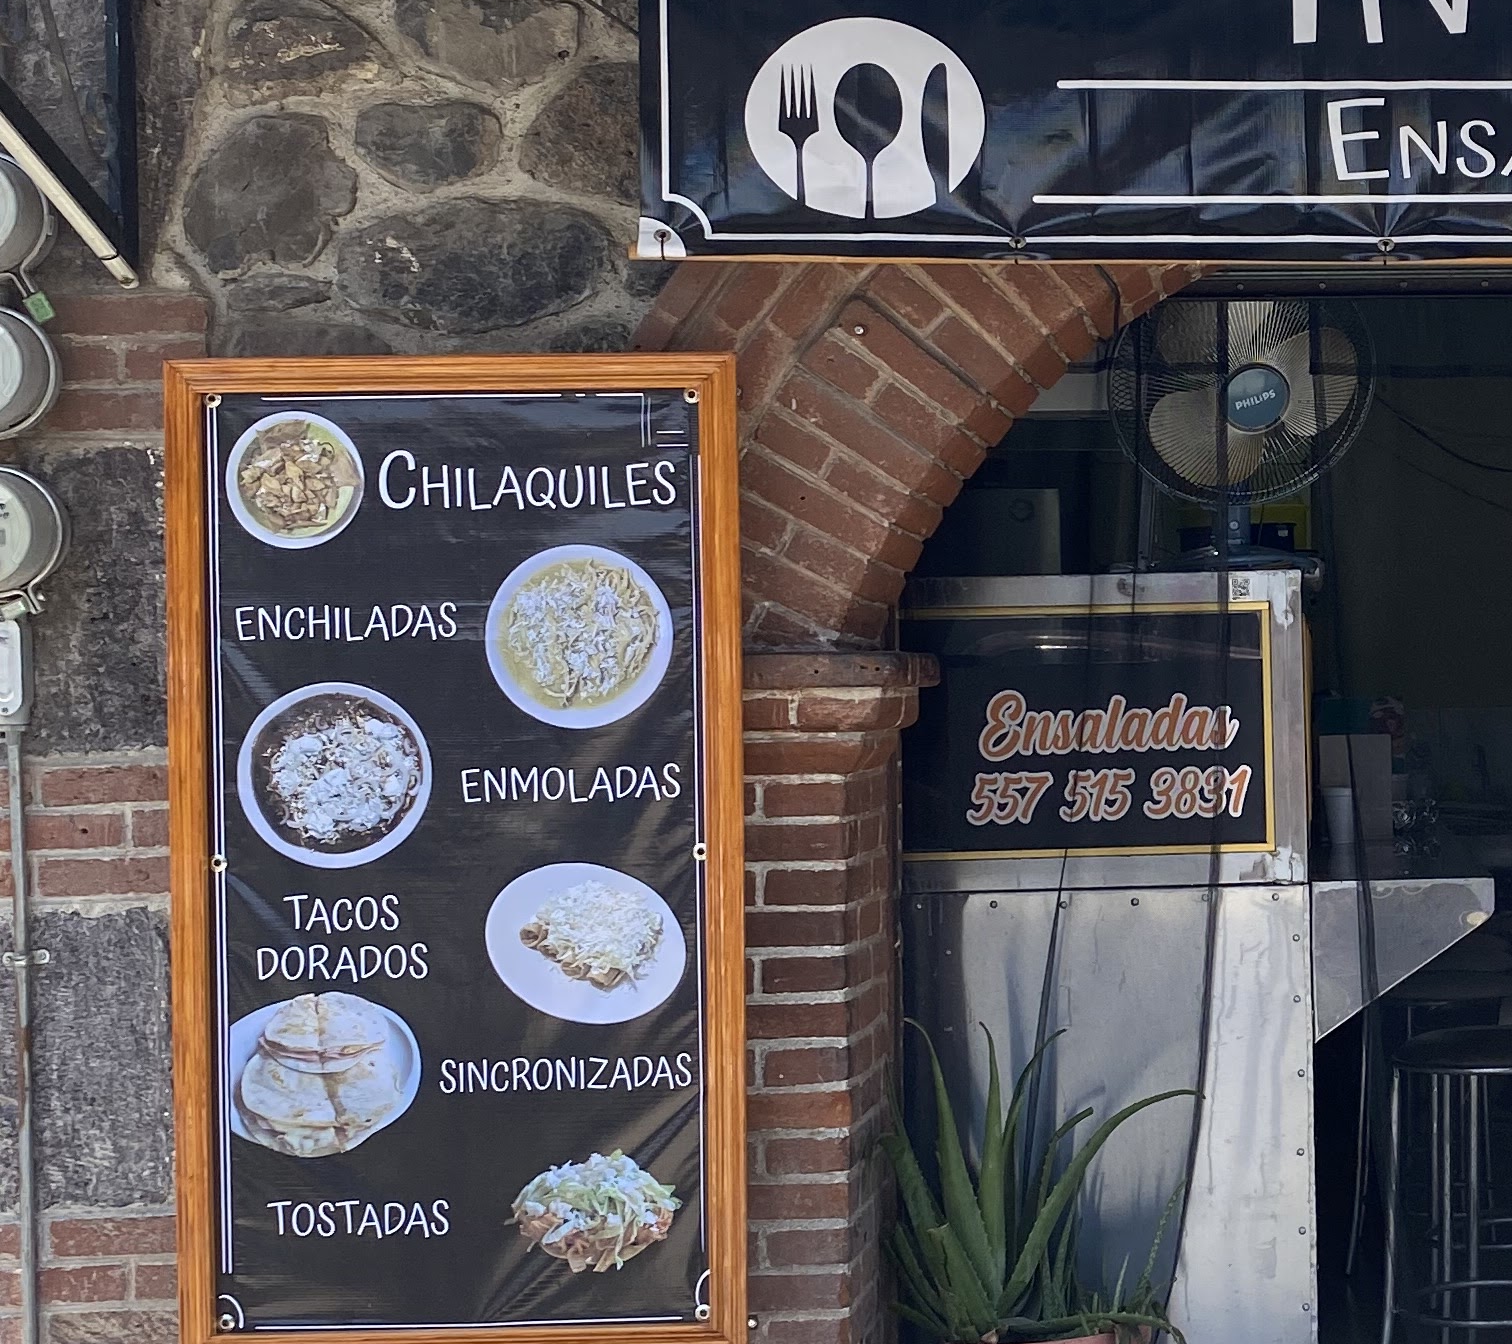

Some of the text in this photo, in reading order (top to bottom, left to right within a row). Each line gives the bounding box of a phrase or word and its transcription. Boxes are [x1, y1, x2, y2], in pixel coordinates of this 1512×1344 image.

[378, 450, 677, 510] CHILAQUILES
[235, 602, 458, 642] ENCHILADAS
[978, 689, 1240, 763] Ensaladas
[460, 762, 682, 804] ENMOLADAS
[966, 770, 1054, 826] 557
[1058, 767, 1137, 823] 515
[283, 894, 400, 935] TACOS
[256, 942, 430, 983] DORADOS
[438, 1053, 693, 1094] SINCRONIZADAS
[267, 1199, 450, 1239] TOSTADAS
